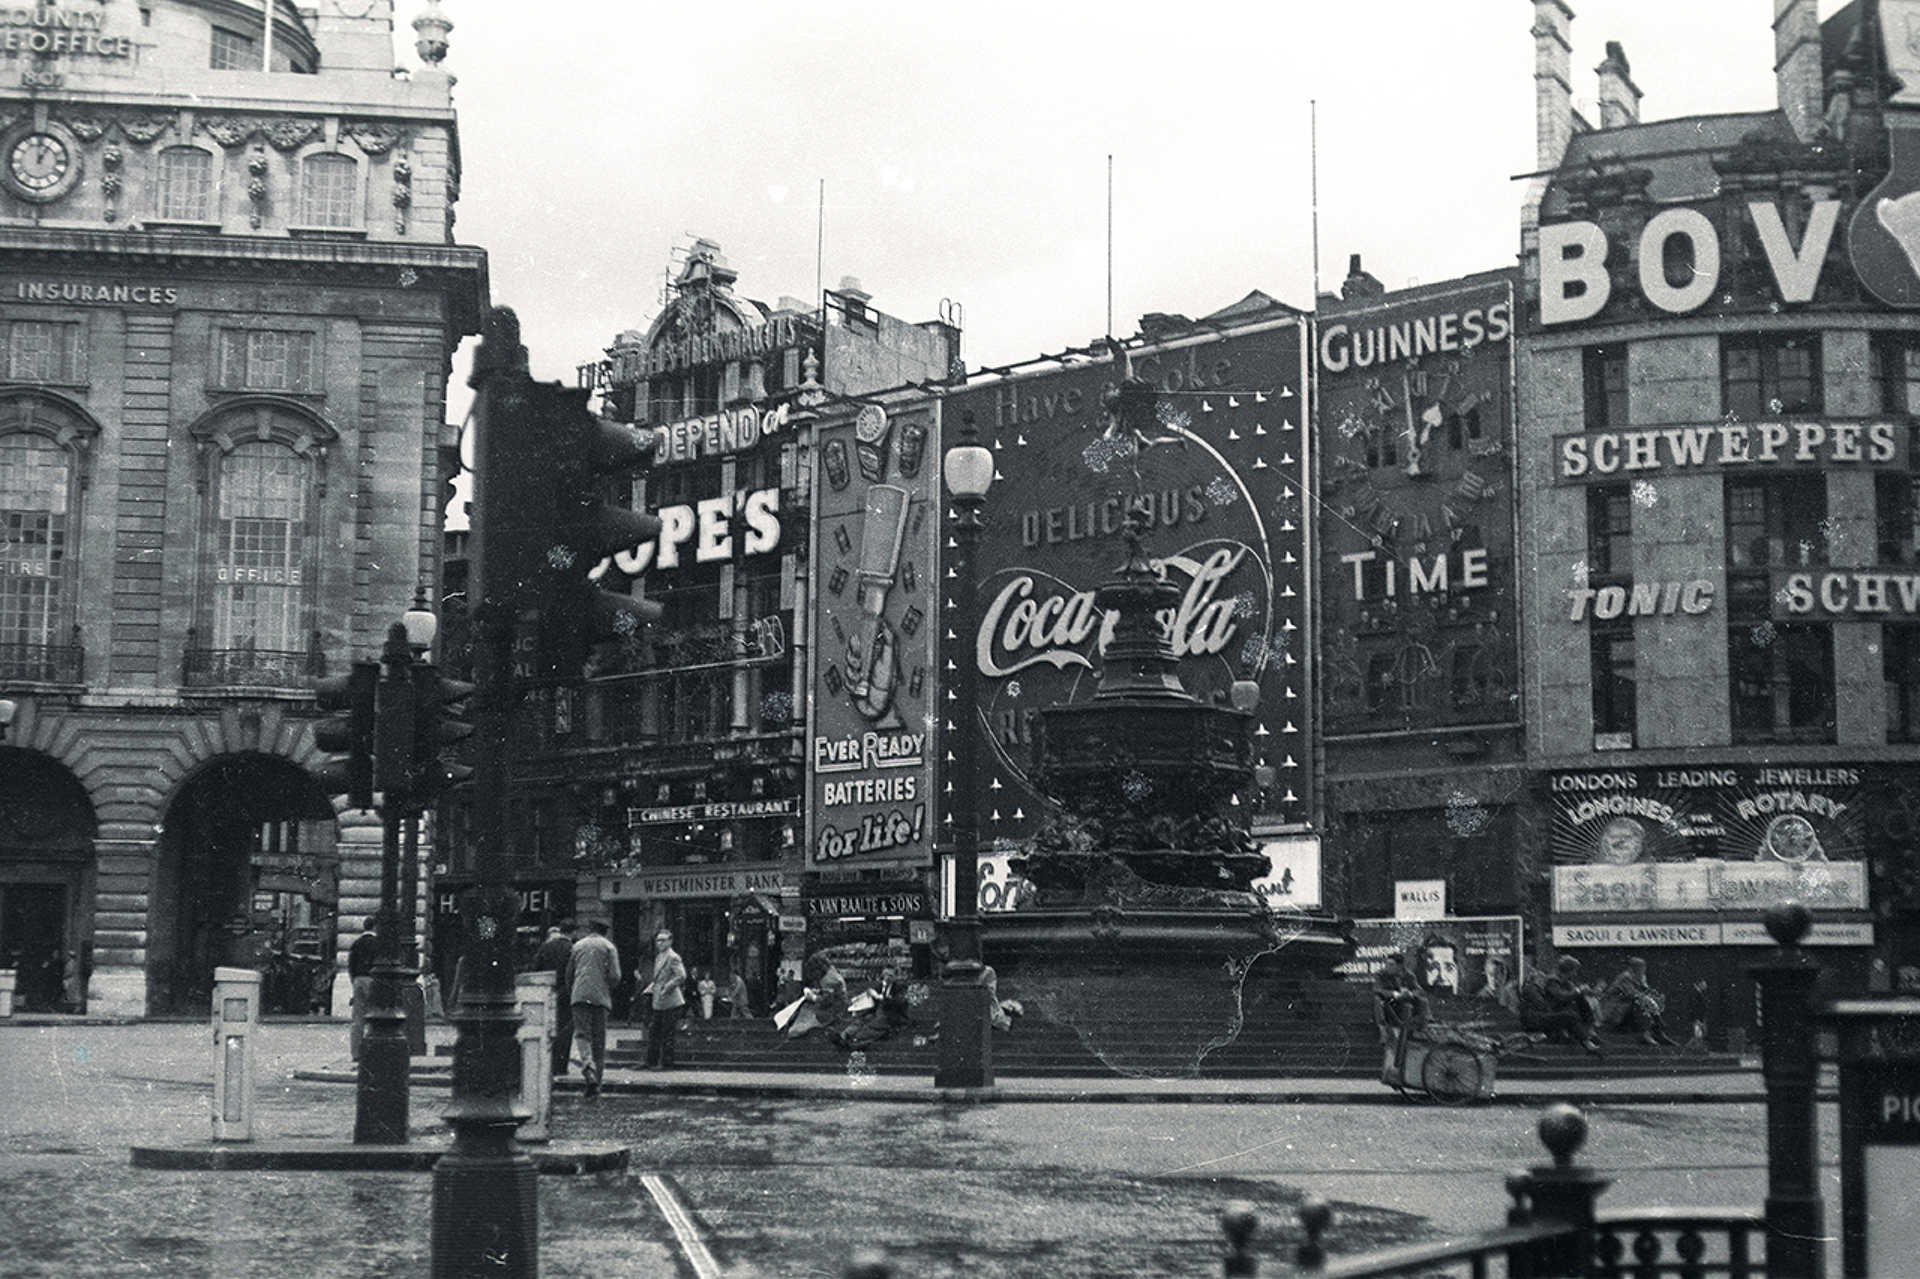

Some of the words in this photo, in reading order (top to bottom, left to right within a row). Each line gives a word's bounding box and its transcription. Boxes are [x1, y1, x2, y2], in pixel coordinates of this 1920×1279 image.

[29, 32, 129, 55] OFFICE
[17, 282, 178, 304] INSURANCES
[1320, 303, 1510, 373] GUINNESS
[652, 405, 760, 467] DEPEND
[1562, 422, 1896, 476] SCHWEPPES
[587, 487, 781, 580] PE'S
[217, 567, 301, 584] OFFICE
[1341, 548, 1488, 601] TIME
[976, 547, 1247, 677] Cocaola
[1568, 579, 1715, 621] TONIC
[863, 731, 925, 769] READY
[823, 776, 917, 806] BATTERIES
[1657, 770, 1738, 789] LEADING
[1755, 768, 1861, 786] JEWELLERS
[640, 807, 697, 822] CHINESE
[704, 799, 793, 818] RESTAURANT
[1567, 794, 1675, 826] LONGINES
[1736, 789, 1848, 822] ROTARY
[815, 823, 860, 862] for
[858, 803, 927, 853] life!
[643, 875, 736, 894] WESTMINSTER
[745, 871, 783, 891] BANK
[1400, 890, 1441, 903] WALLIS
[440, 893, 459, 914] H.
[890, 895, 920, 911] SONS
[1566, 930, 1610, 942] SAQUI
[1630, 928, 1706, 942] LAWRENCE
